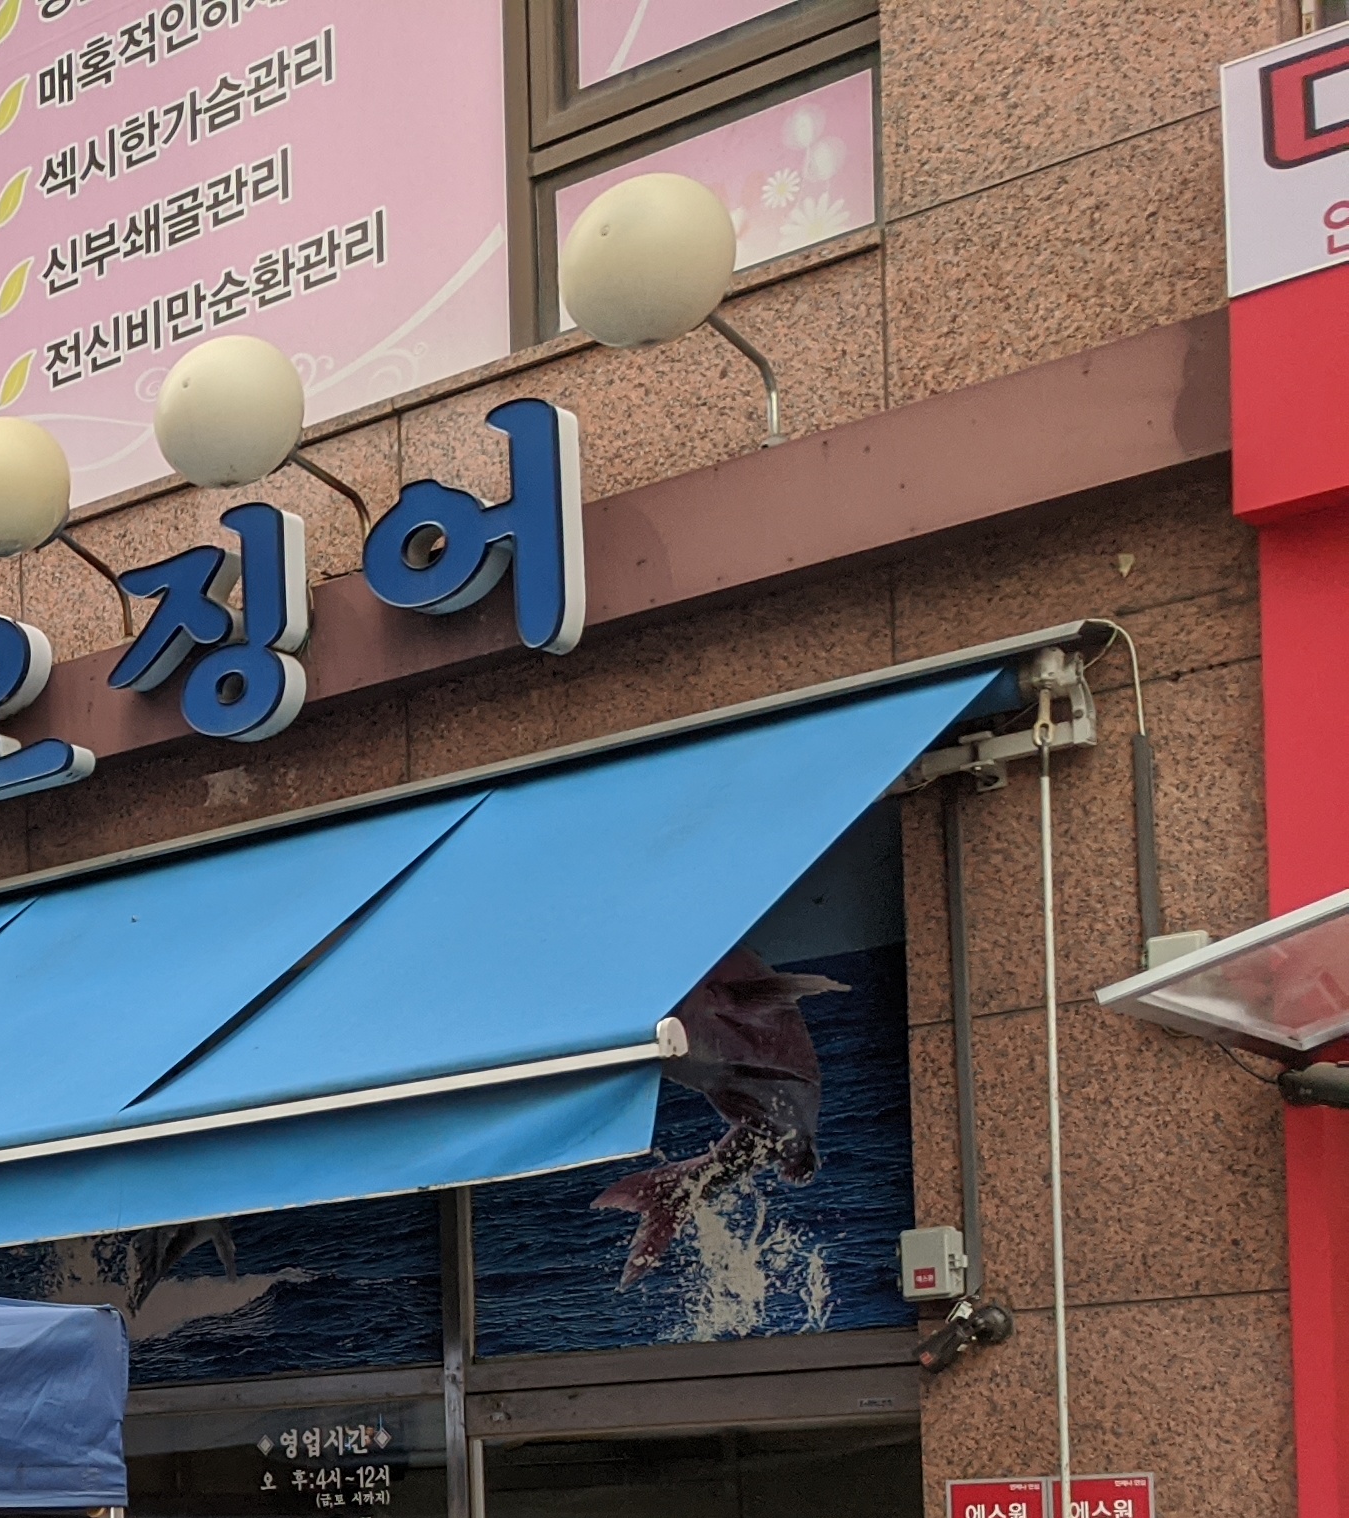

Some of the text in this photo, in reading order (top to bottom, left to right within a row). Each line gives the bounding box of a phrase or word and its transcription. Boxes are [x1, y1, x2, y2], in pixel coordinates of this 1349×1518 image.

[39, 0, 287, 105] 매혹적인
[39, 28, 333, 196] 섹시한가슴관리
[42, 146, 290, 295] 신부쇄골관리
[45, 208, 385, 389] 전신비만순환관리
[260, 1471, 277, 1491] 오
[280, 1424, 369, 1459] 영업시간
